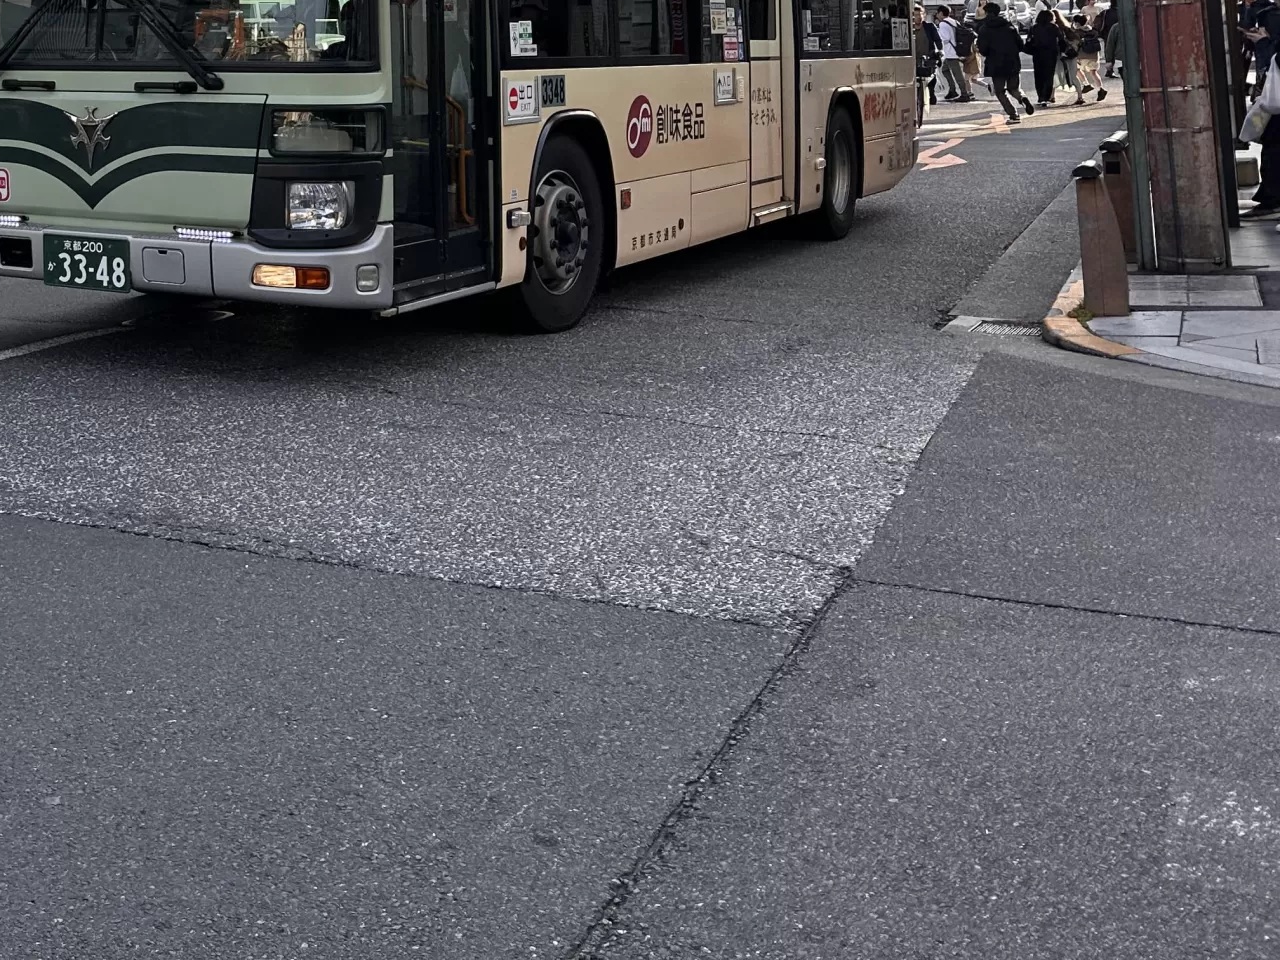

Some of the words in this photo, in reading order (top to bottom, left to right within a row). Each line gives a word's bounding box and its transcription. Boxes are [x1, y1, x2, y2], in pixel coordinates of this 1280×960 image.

[518, 84, 533, 100] 出口
[541, 77, 566, 105] 3348
[520, 102, 532, 112] EXIT
[656, 102, 706, 144] 創味食品
[63, 239, 104, 254] 京都200
[631, 225, 677, 251] 京都市交通局
[47, 261, 56, 272] か
[58, 252, 126, 288] 33-48
